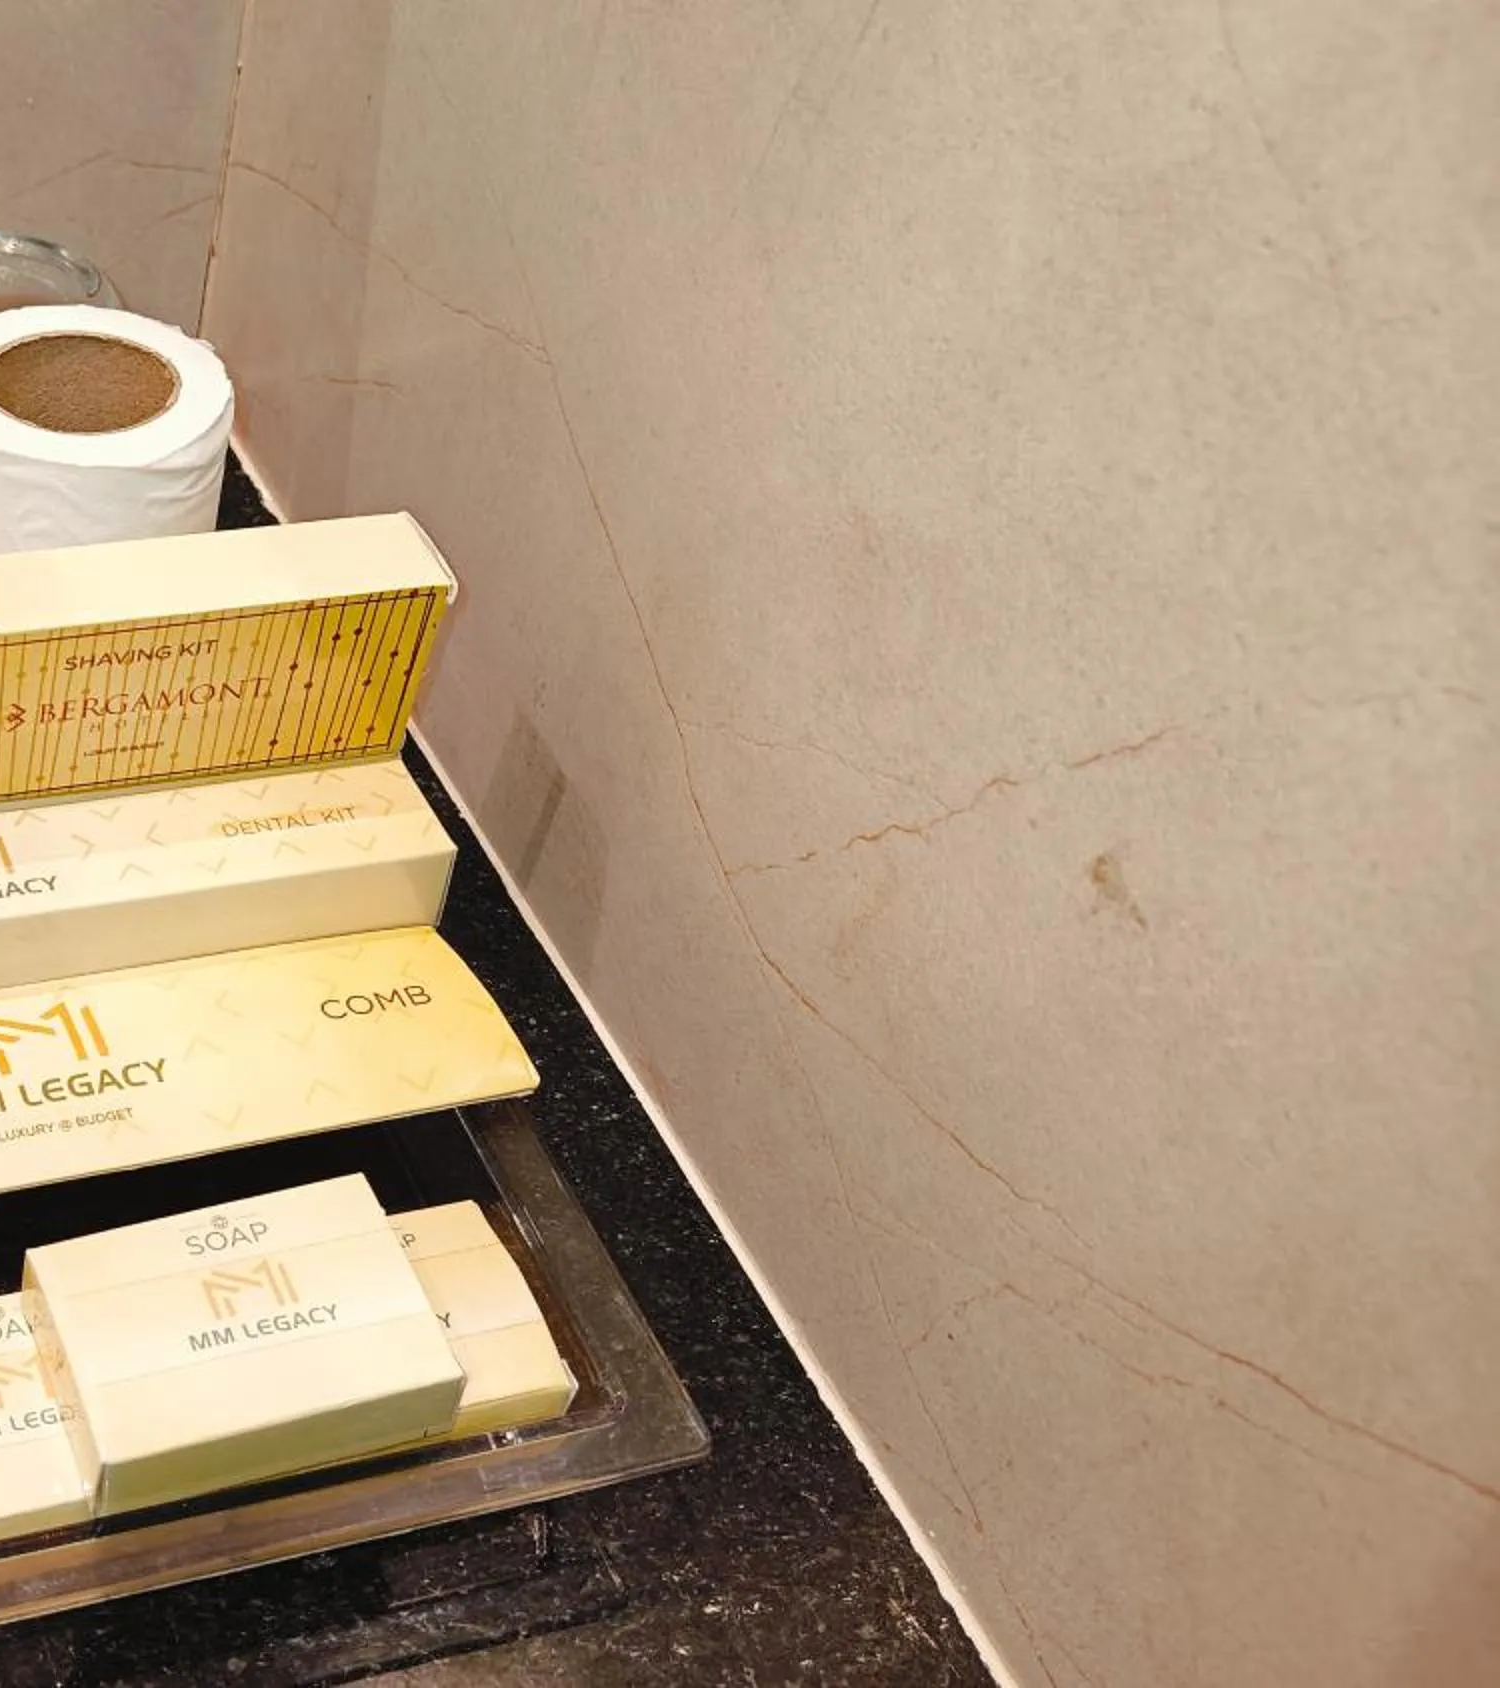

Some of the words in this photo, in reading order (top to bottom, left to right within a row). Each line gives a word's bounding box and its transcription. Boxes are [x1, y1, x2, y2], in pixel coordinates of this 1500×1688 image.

[63, 645, 173, 671] SHAVING
[178, 639, 220, 658] KIT
[39, 677, 270, 724] BERGAMONT
[220, 813, 316, 838] DENTAL
[322, 805, 358, 824] KIT
[320, 985, 432, 1020] COMB
[18, 1058, 167, 1107] LEGACY
[75, 1107, 134, 1128] BUDGET
[184, 1221, 268, 1256] SOAP
[188, 1326, 236, 1352] MM
[241, 1304, 338, 1340] LEGACY
